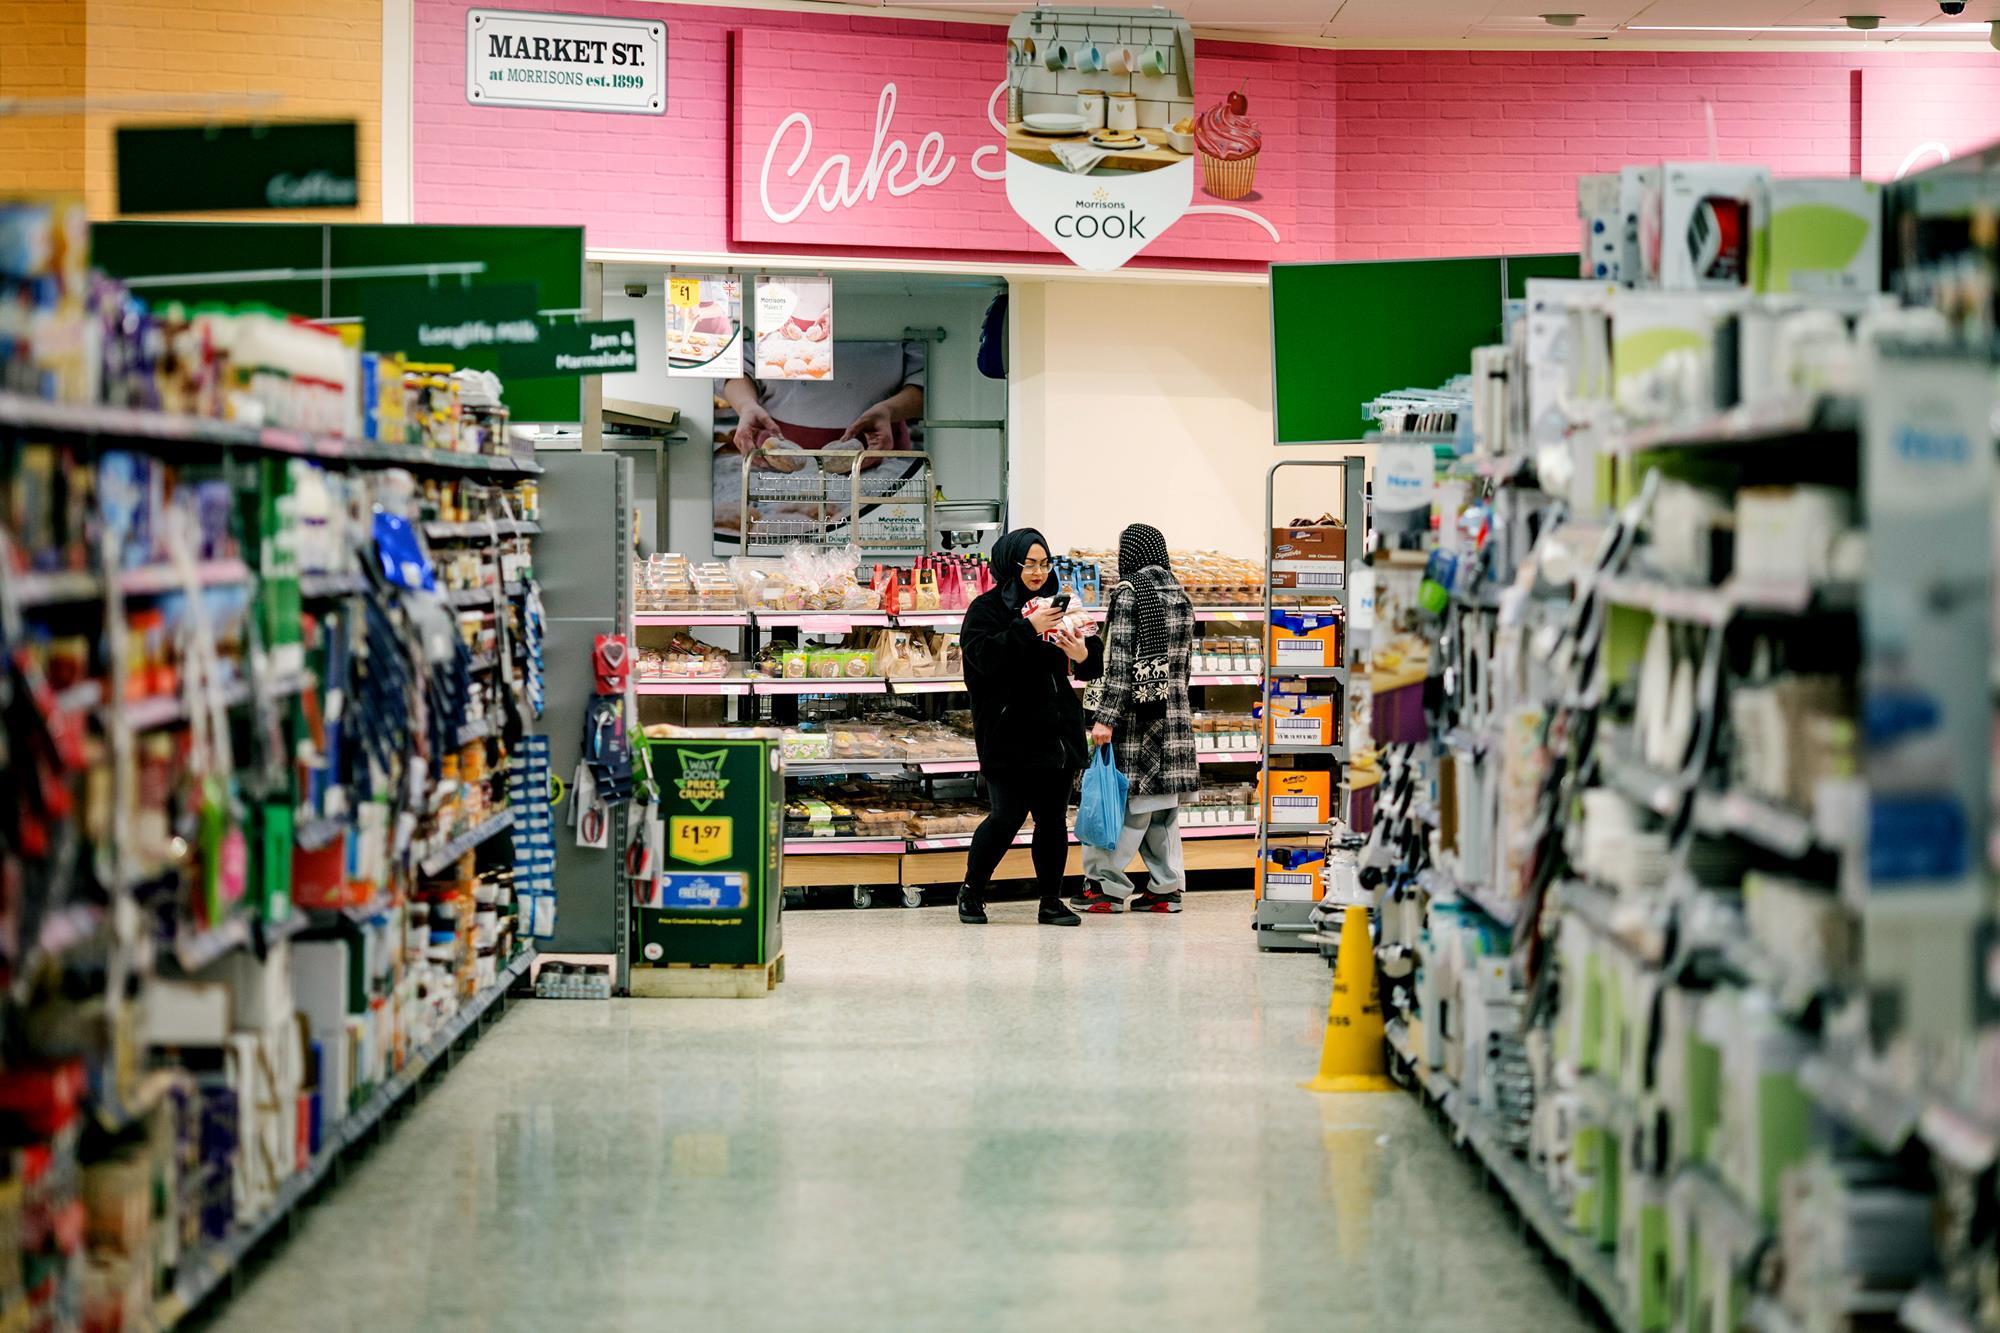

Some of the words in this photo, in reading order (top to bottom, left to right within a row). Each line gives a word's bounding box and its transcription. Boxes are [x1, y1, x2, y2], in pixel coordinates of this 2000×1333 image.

[489, 35, 606, 64] MARKET
[612, 43, 645, 66] ST.
[489, 69, 503, 81] at
[507, 69, 583, 86] MORRISONS
[760, 82, 956, 224] Cake
[1076, 200, 1125, 209] Morrisons
[1055, 210, 1146, 239] cook
[680, 285, 690, 301] £1
[591, 333, 619, 350] Jam
[621, 331, 633, 347] &
[556, 351, 635, 370] Marmalade
[688, 760, 714, 770] WAY
[683, 770, 720, 780] DOWN
[687, 780, 716, 789] PRICE
[679, 790, 725, 800] CRUNCH
[682, 825, 720, 844] £1.97
